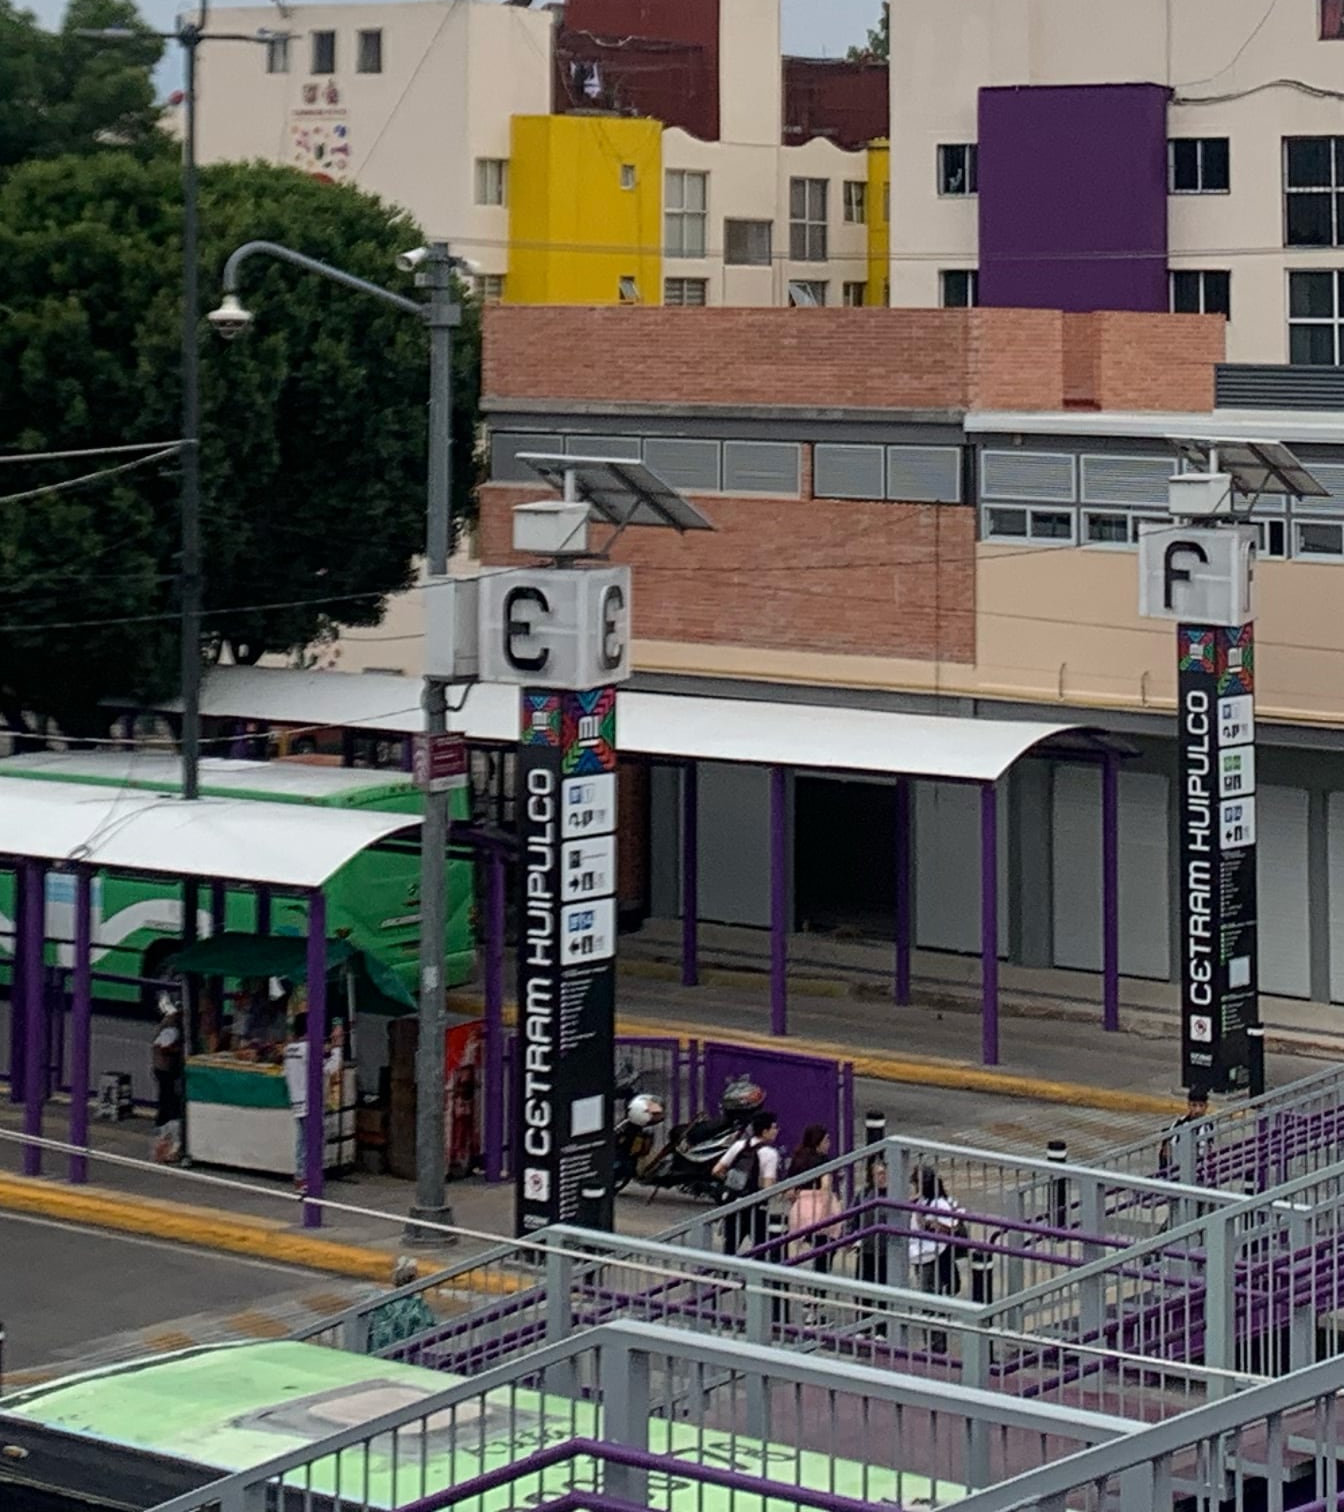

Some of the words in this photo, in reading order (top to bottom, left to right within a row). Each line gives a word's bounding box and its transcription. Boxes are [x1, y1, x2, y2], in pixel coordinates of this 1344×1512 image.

[503, 586, 550, 672] E
[599, 585, 625, 670] E
[1164, 541, 1209, 609] F
[1186, 691, 1210, 852] HUIPULCO
[526, 768, 555, 966] HUIPULCO
[1188, 860, 1212, 1005] CETRAM
[524, 977, 553, 1156] CETRAM
